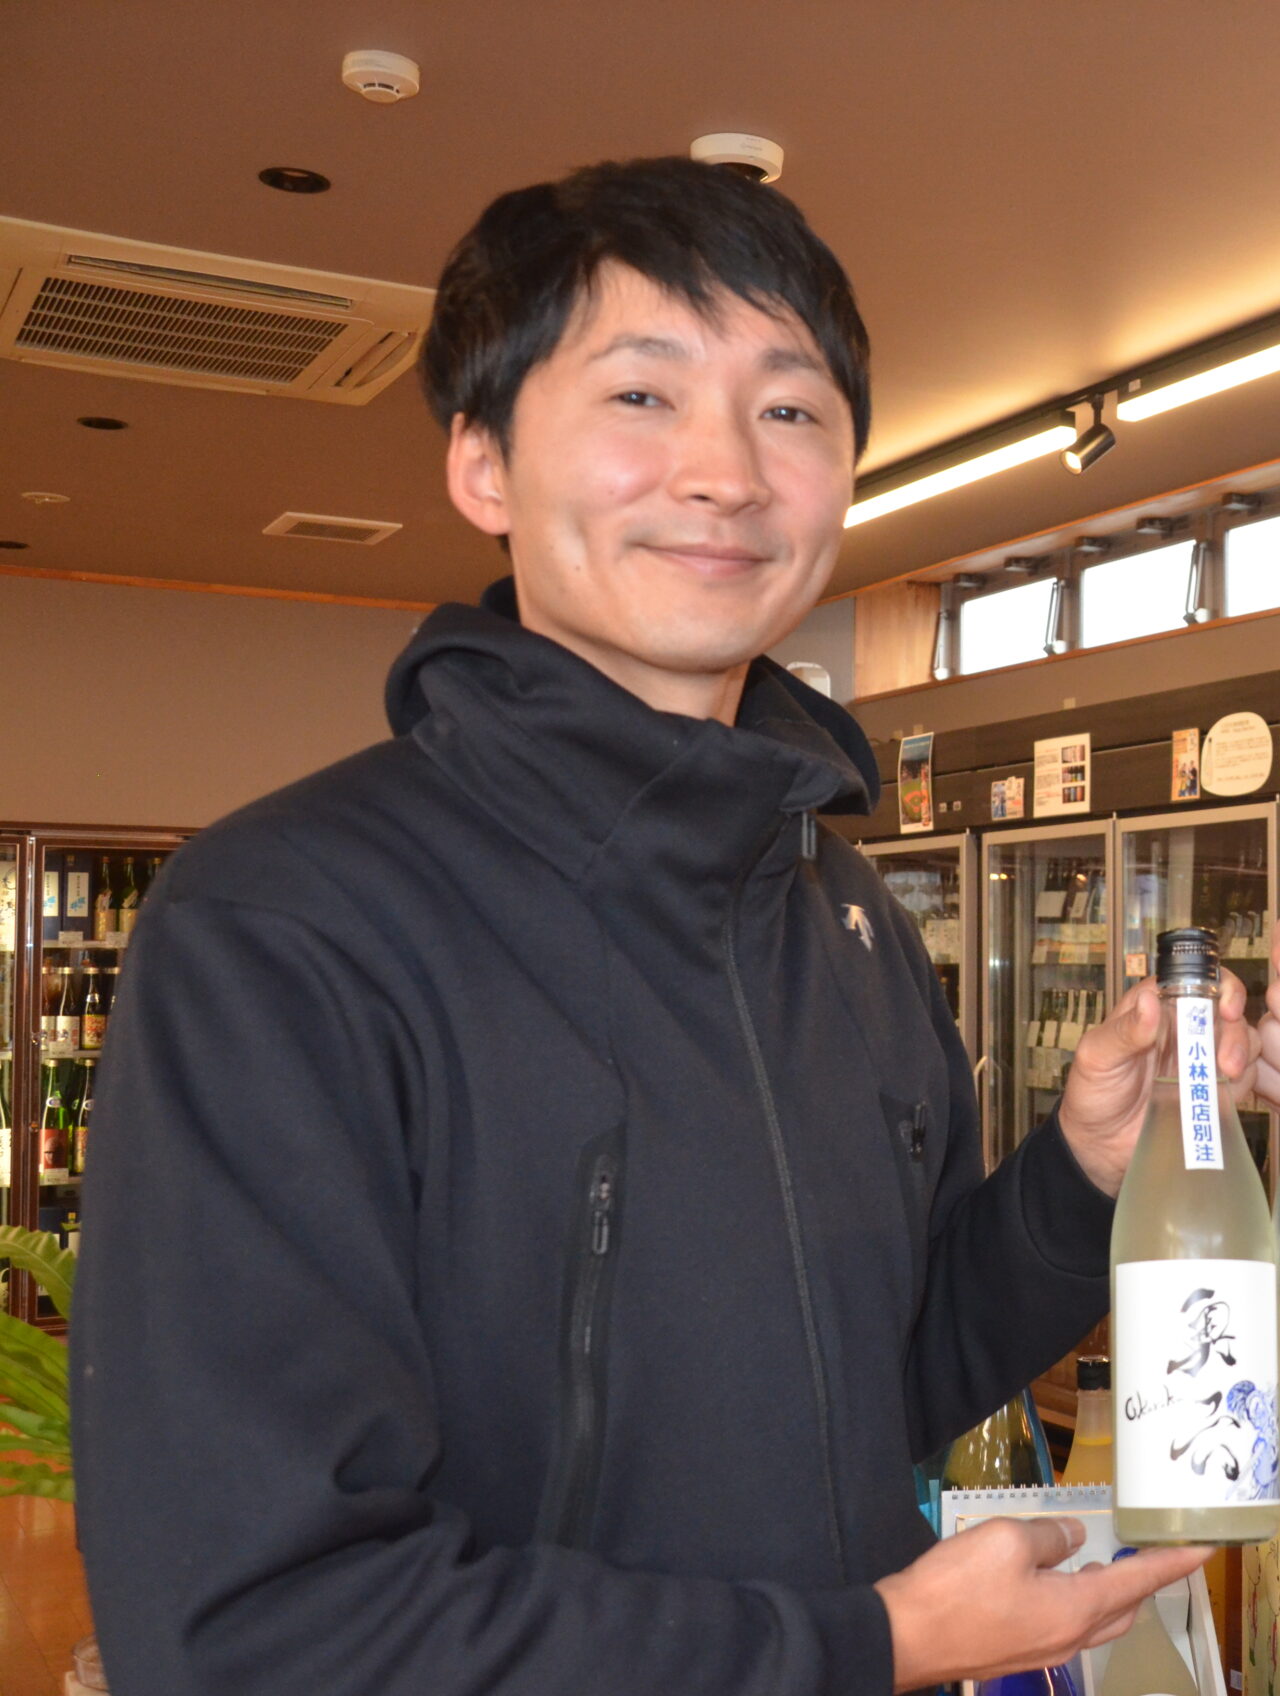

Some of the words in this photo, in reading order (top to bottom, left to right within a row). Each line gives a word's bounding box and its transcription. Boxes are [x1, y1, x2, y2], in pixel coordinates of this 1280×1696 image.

[1188, 1042, 1216, 1162] 小林商店別注
